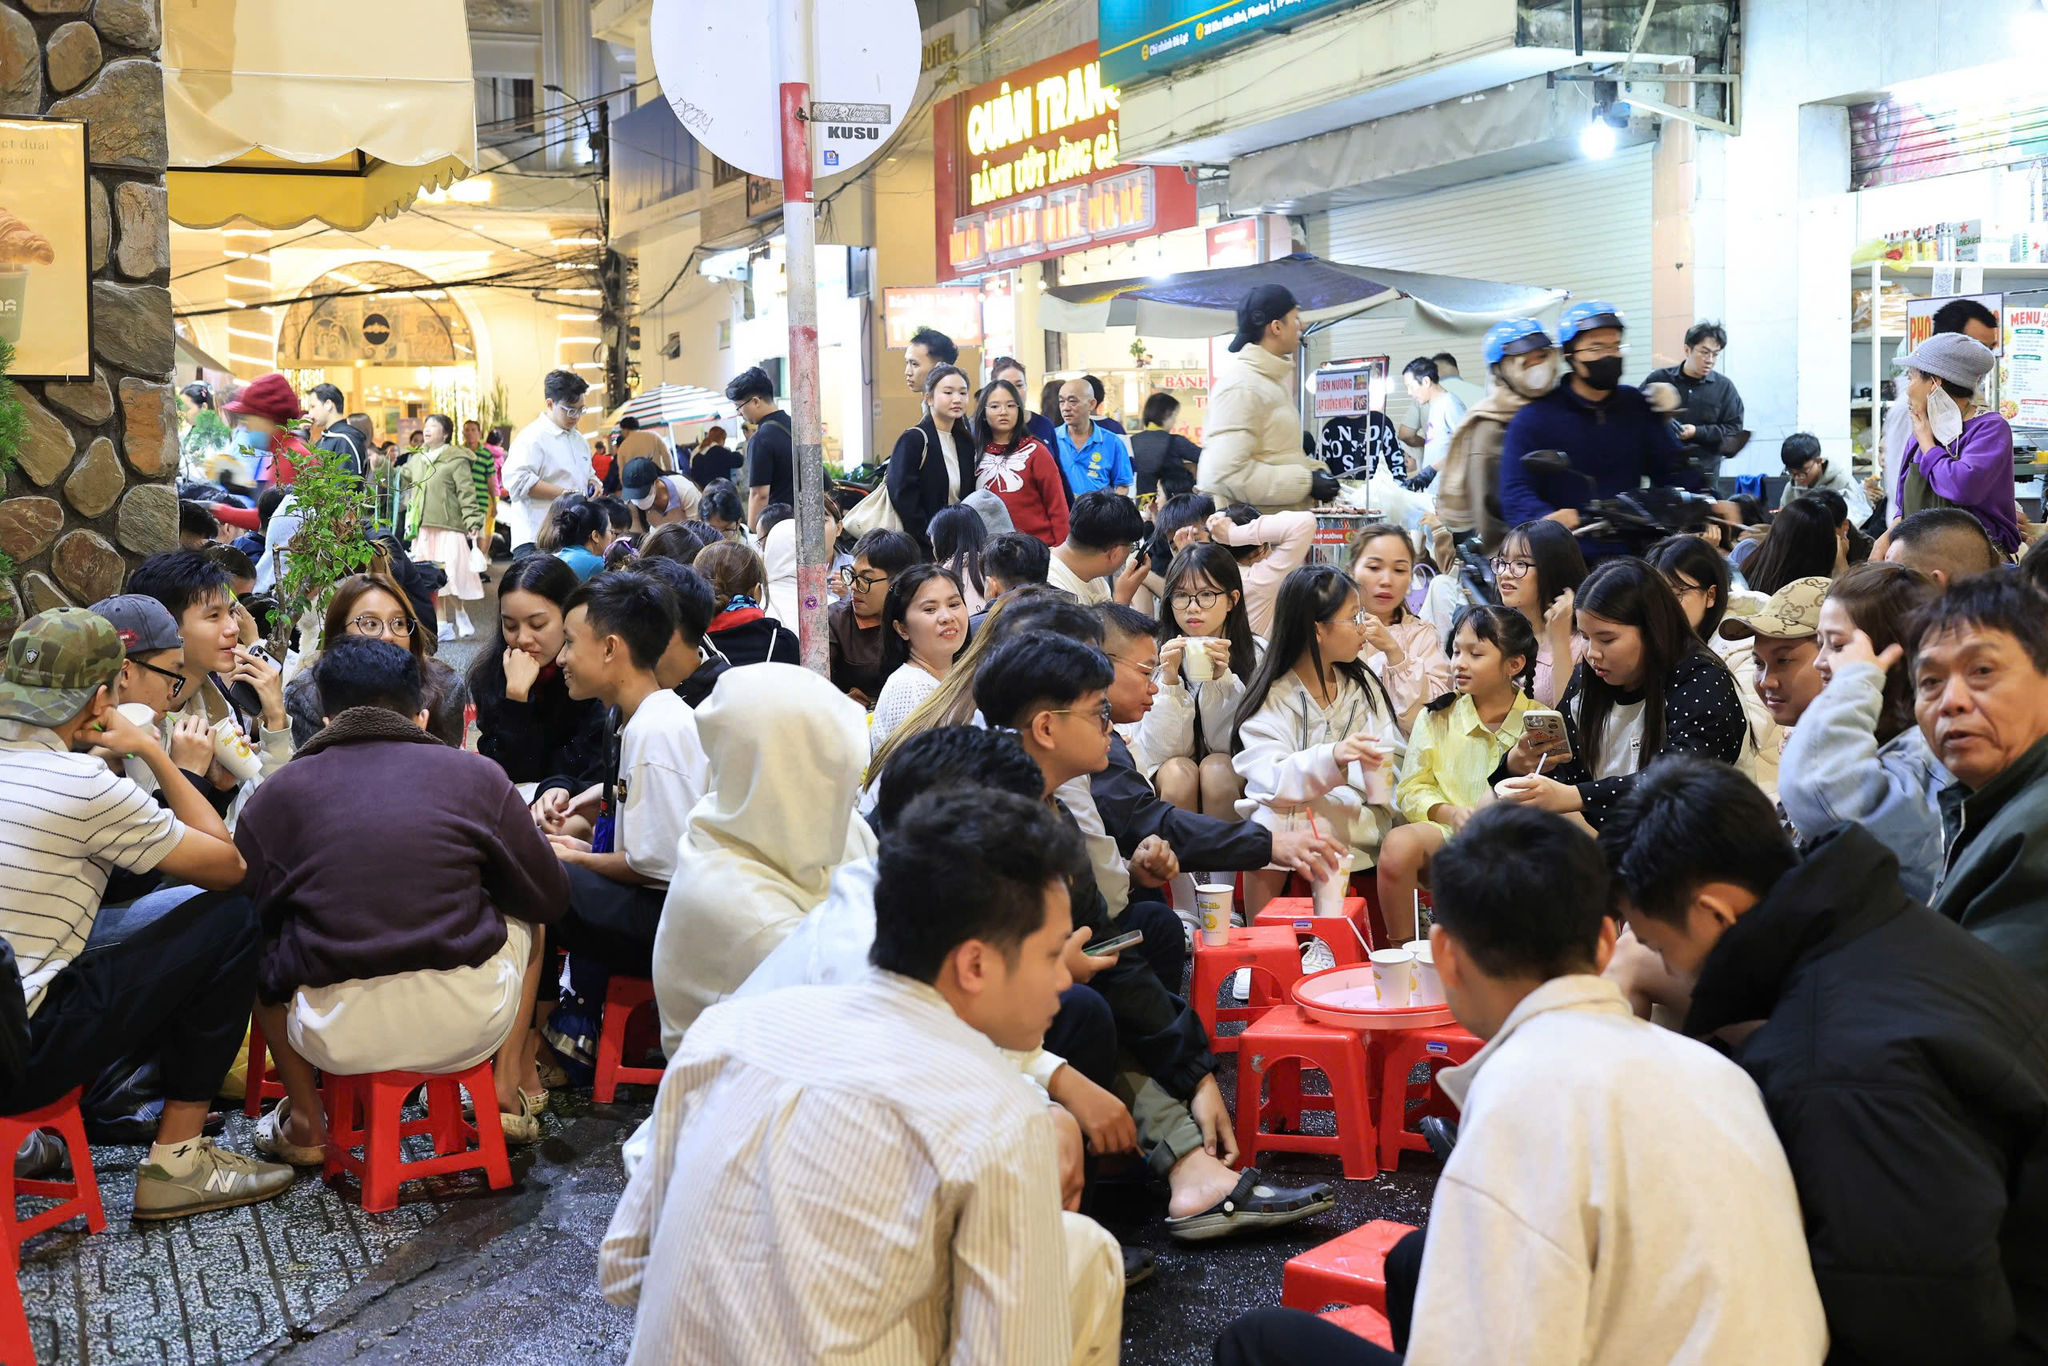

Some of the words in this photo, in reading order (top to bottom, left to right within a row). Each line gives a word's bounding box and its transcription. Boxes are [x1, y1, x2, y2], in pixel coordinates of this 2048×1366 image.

[827, 126, 879, 140] KUSU
[970, 160, 1013, 207] BÁNH
[1955, 232, 1981, 248] ineken
[2010, 310, 2042, 328] MENU
